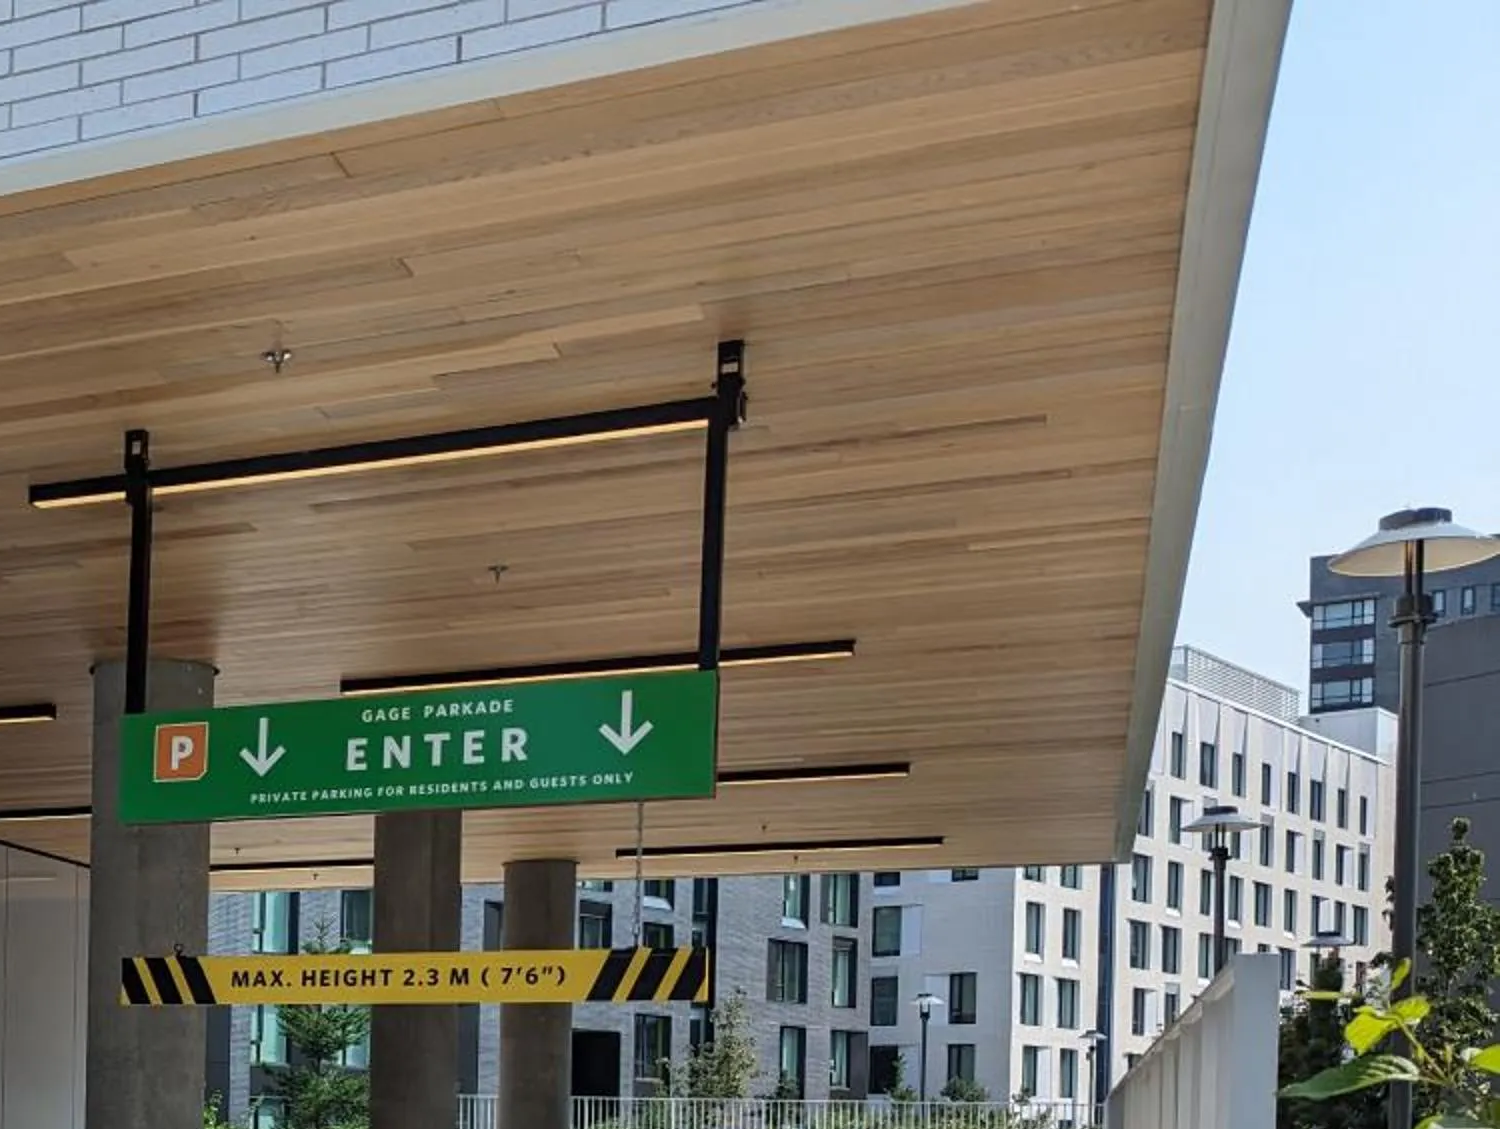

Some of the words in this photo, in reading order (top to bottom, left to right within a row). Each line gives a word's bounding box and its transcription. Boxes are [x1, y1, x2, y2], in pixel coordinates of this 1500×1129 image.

[361, 707, 411, 723] GAGE
[423, 699, 514, 718] PARKADE
[170, 736, 194, 770] P
[346, 727, 528, 771] ENTER
[250, 790, 307, 804] PRIVATE
[312, 787, 373, 801] PARKING
[377, 785, 404, 798] FOR
[409, 780, 488, 796] RESIDENTS
[493, 779, 524, 791] AND
[529, 775, 587, 790] GUESTS
[592, 772, 634, 786] ONLY
[231, 969, 292, 988] MAX.
[301, 968, 393, 987] HEIGHT
[403, 967, 440, 987] 2.3
[449, 967, 469, 986] M
